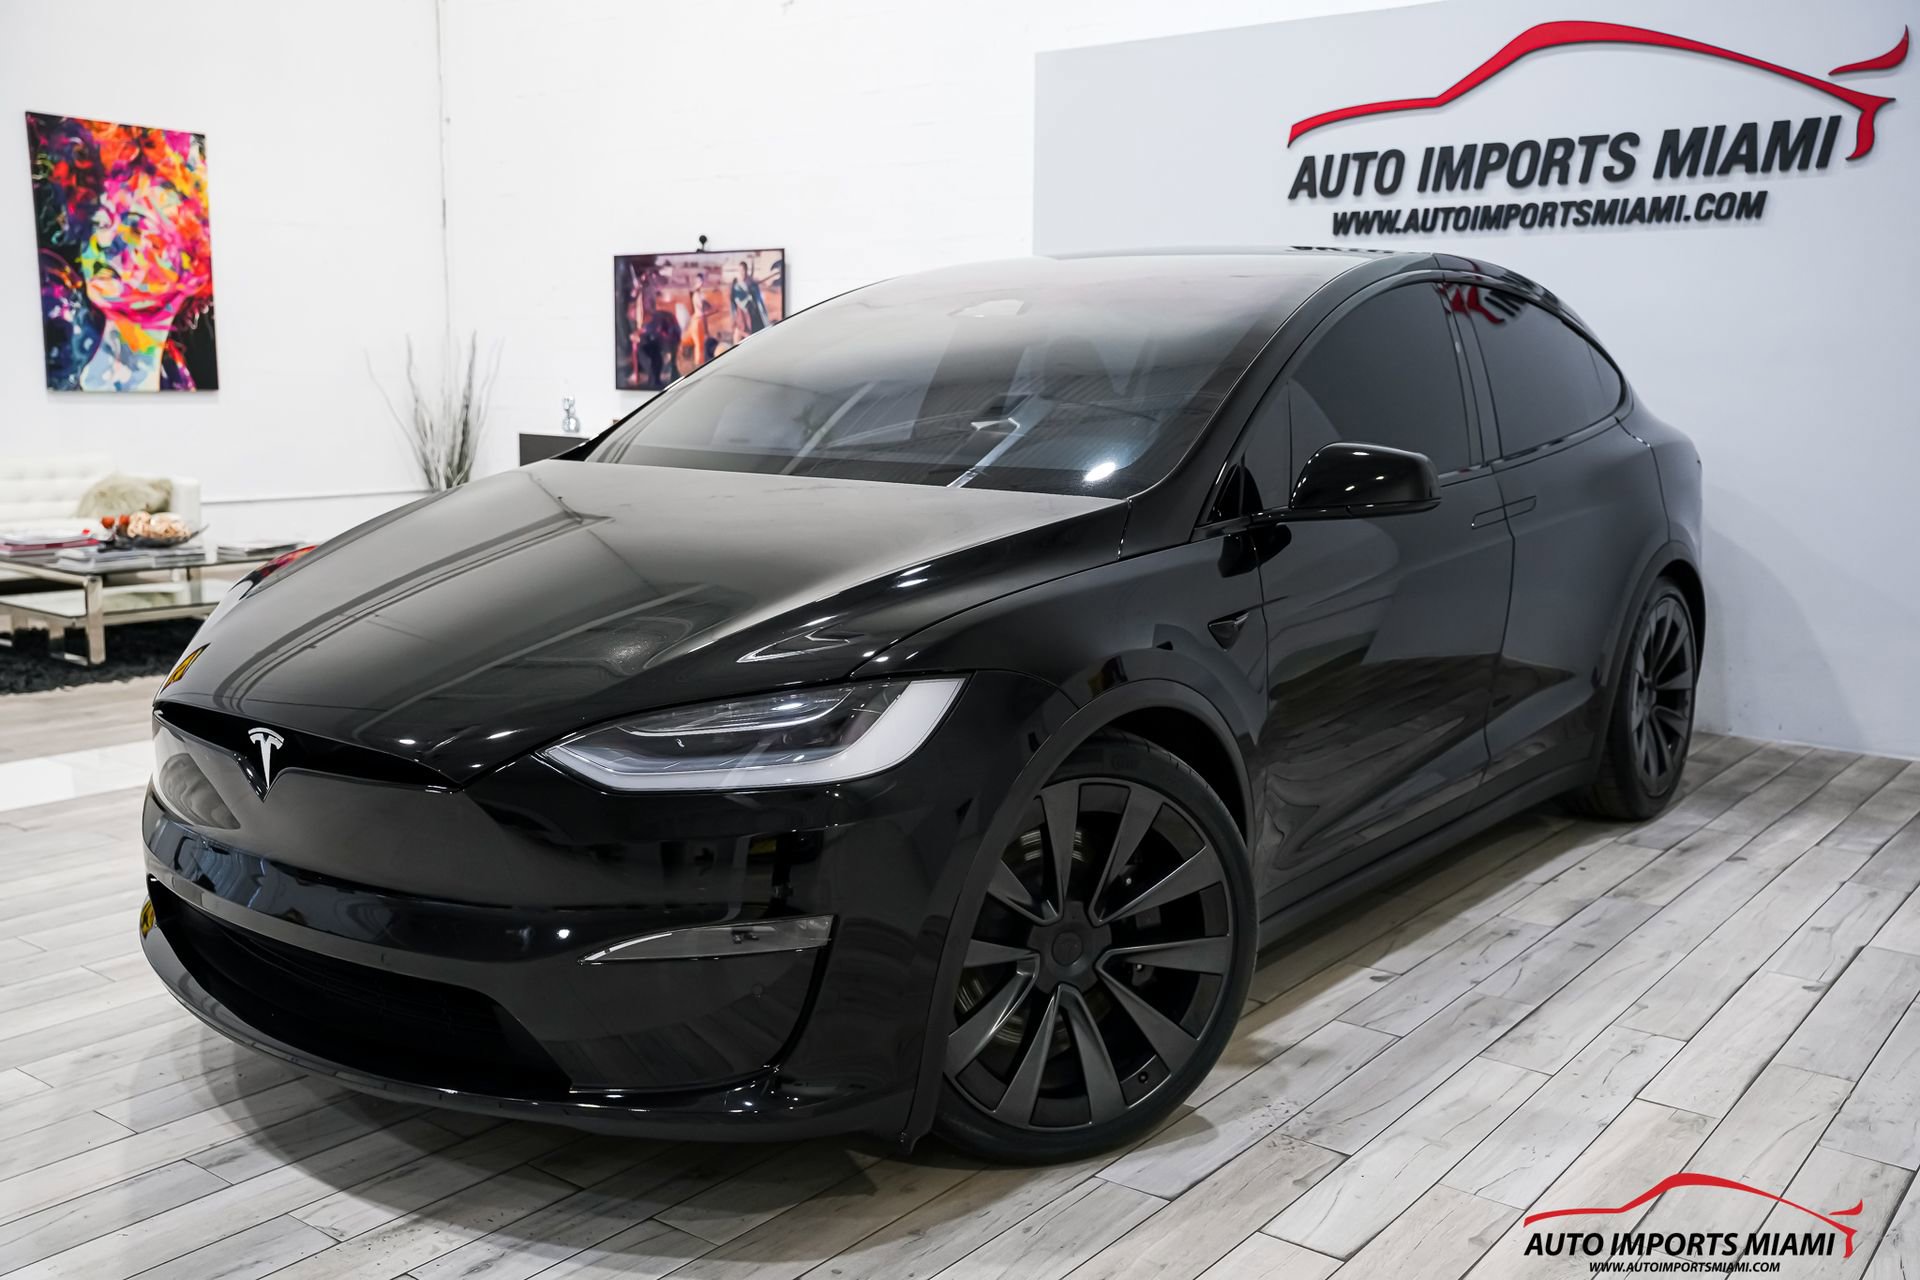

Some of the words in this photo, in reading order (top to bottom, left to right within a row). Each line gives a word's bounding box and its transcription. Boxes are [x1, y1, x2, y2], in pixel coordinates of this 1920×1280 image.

[1287, 149, 1406, 200] AUTO
[1417, 131, 1641, 193] IMPORTS
[1652, 115, 1842, 180] MIAMI
[1332, 190, 1768, 236] WWW.AUTOIMPORTSMIAMI.COM
